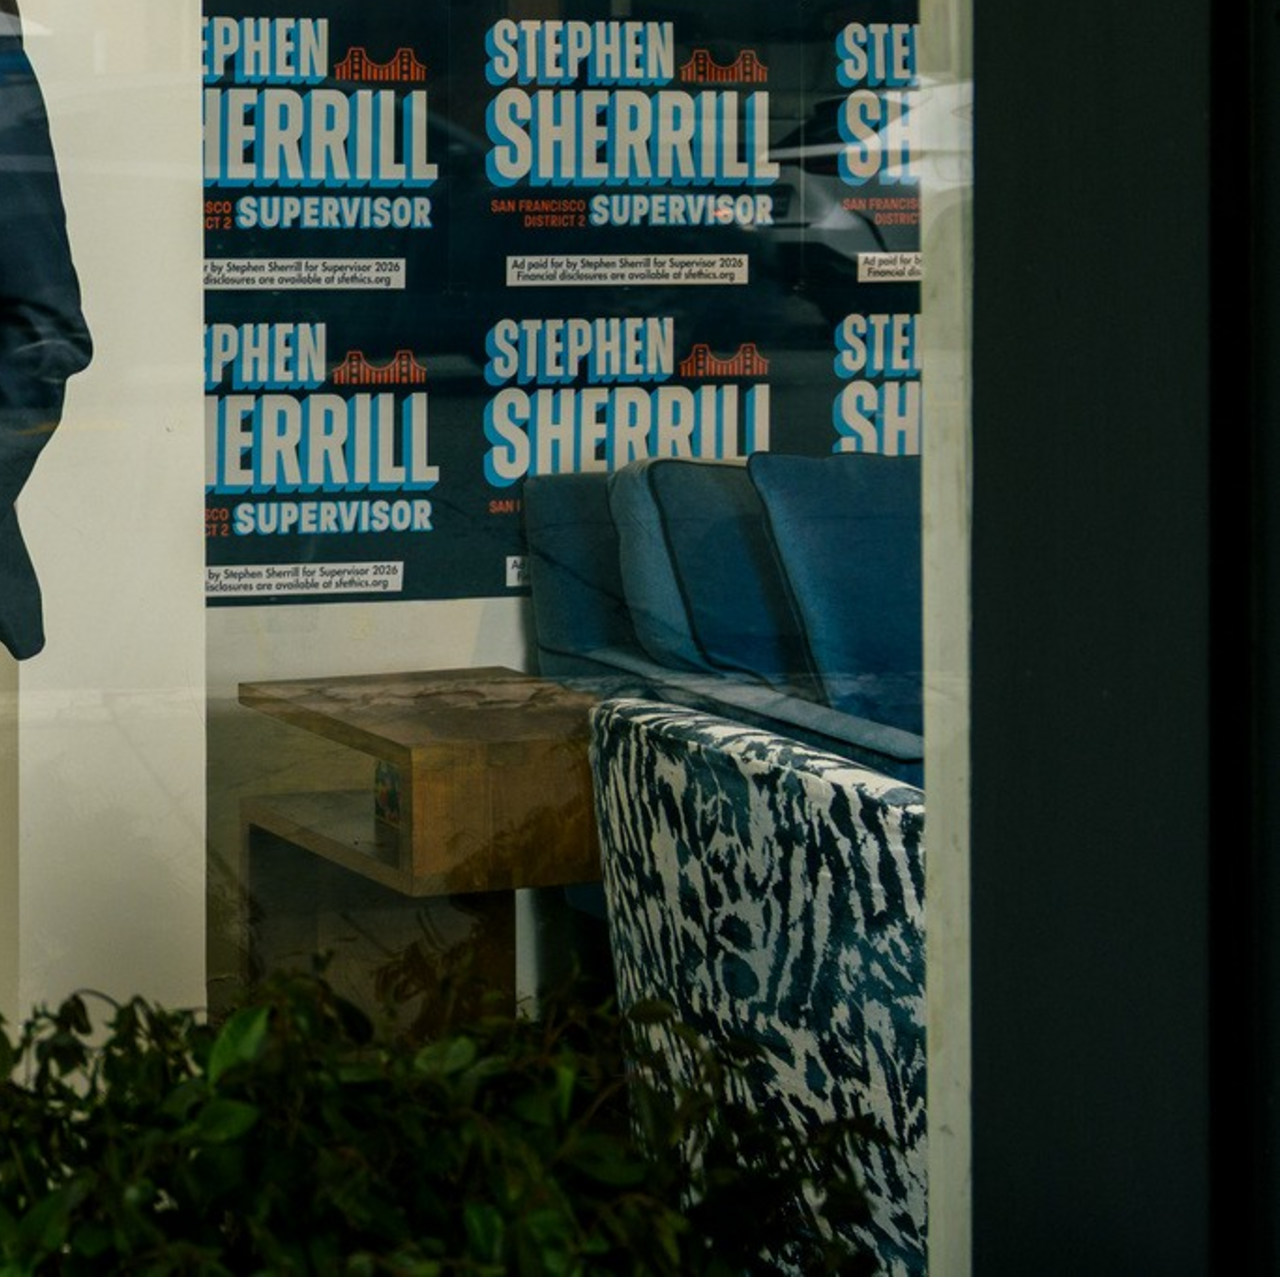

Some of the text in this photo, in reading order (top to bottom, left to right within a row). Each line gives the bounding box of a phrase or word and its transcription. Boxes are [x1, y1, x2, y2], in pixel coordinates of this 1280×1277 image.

[486, 19, 675, 87] STEPHEN
[485, 88, 780, 190] SHERRILL
[236, 197, 432, 229] SUPERVISOR
[589, 195, 774, 226] SUPERVISOR
[525, 216, 576, 227] DISTRICT
[211, 262, 400, 275] by Stephen Sherrill for Supervisor 2026
[512, 257, 743, 271] Ad paid for by Stephen Sherrill for Supervisor 2026
[204, 275, 255, 284] disclosures
[278, 275, 321, 284] available
[325, 275, 335, 284] at
[337, 274, 391, 287] sfethics.org
[518, 271, 557, 281] Financial
[559, 270, 608, 280] disclosures
[629, 269, 670, 279] available
[673, 269, 683, 278] at
[685, 268, 735, 282] sfethics.org
[485, 317, 675, 387] STEPHEN
[233, 500, 433, 534] SUPERVISOR
[208, 565, 398, 581] by Stephen Sherrill for Supervisor 2026
[276, 580, 319, 590] available
[323, 579, 333, 588] at
[335, 577, 388, 591] sfethics.org
